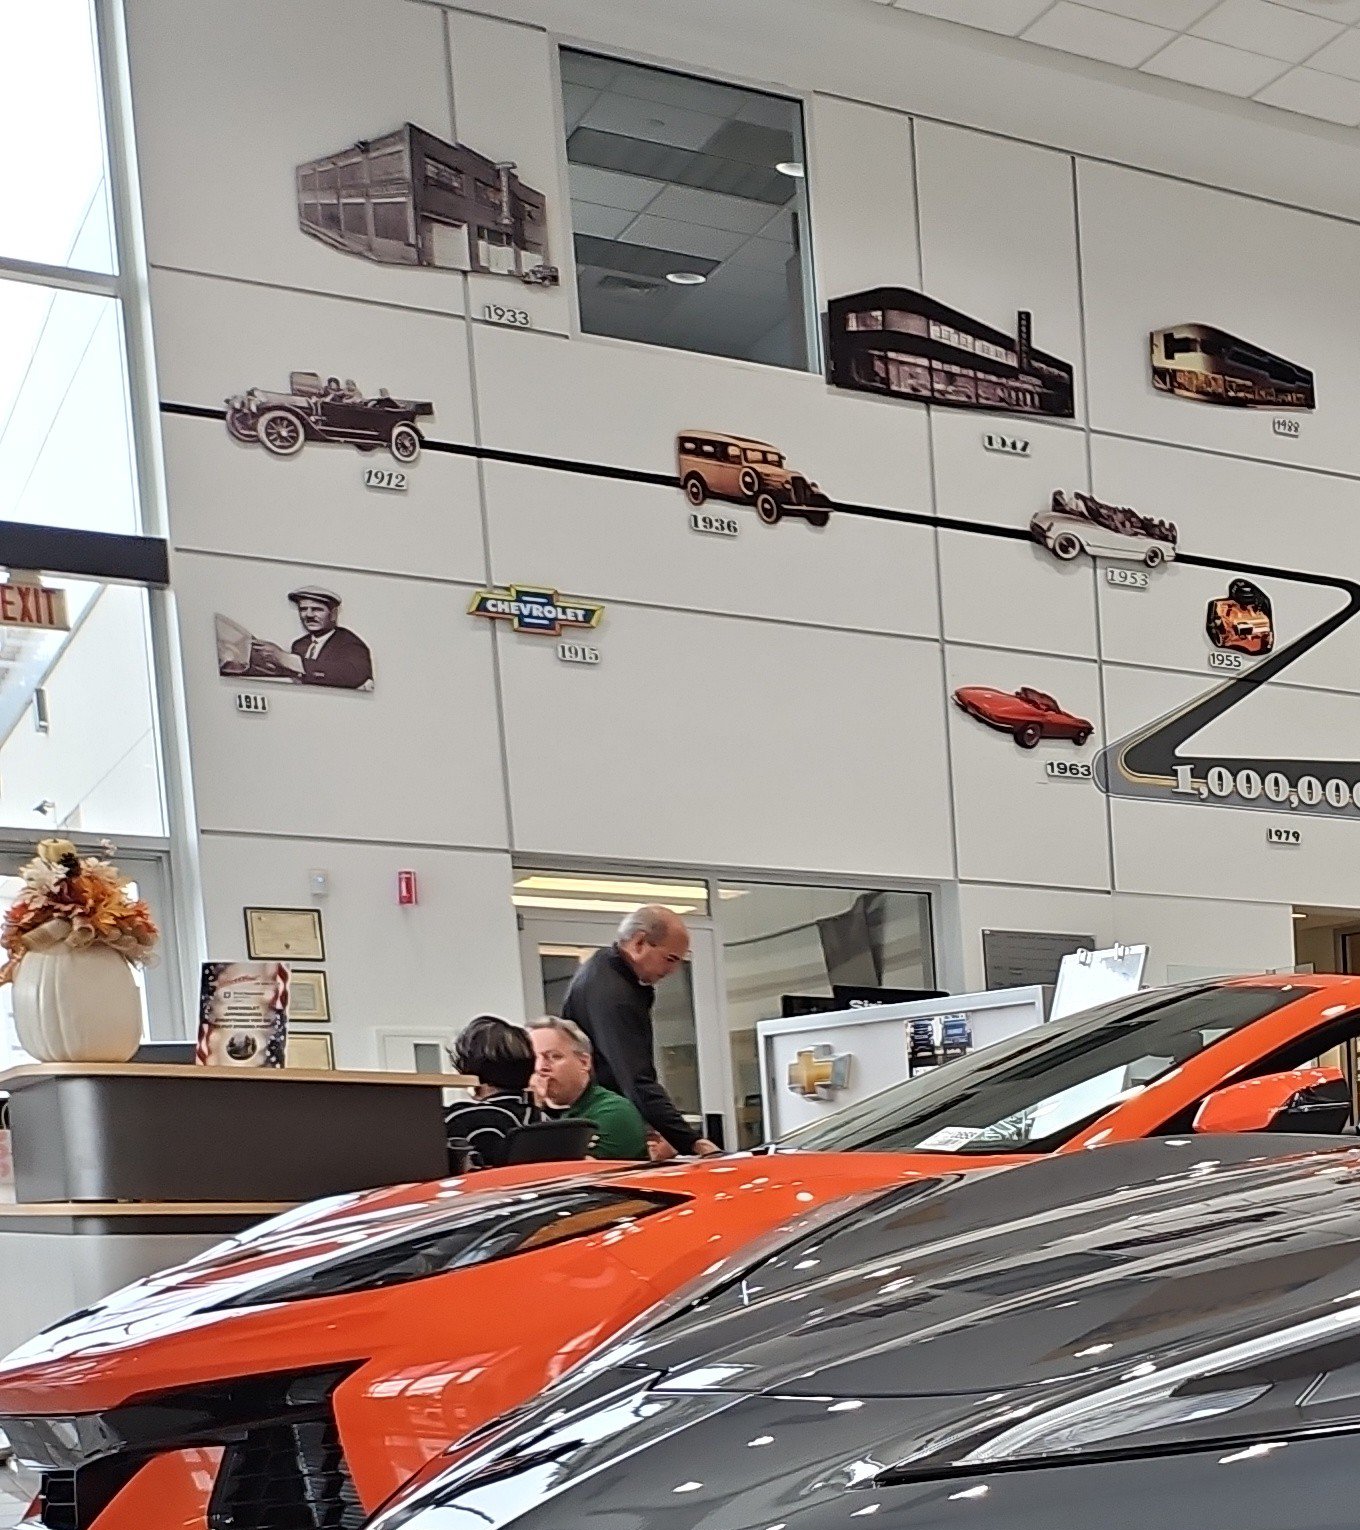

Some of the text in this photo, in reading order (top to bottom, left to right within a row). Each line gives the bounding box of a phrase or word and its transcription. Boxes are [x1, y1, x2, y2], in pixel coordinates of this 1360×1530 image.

[485, 305, 530, 326] 1933
[1276, 419, 1300, 433] 1988
[366, 469, 406, 488] 1912
[691, 514, 739, 534] 1936
[1108, 569, 1149, 587] 1953
[1, 584, 57, 625] EXIT
[486, 599, 586, 622] CHEVROLET
[559, 644, 600, 662] 1915
[1210, 652, 1242, 668] 1955
[237, 693, 267, 711] 1911
[1046, 761, 1092, 777] 1963
[1268, 828, 1301, 843] 1979
